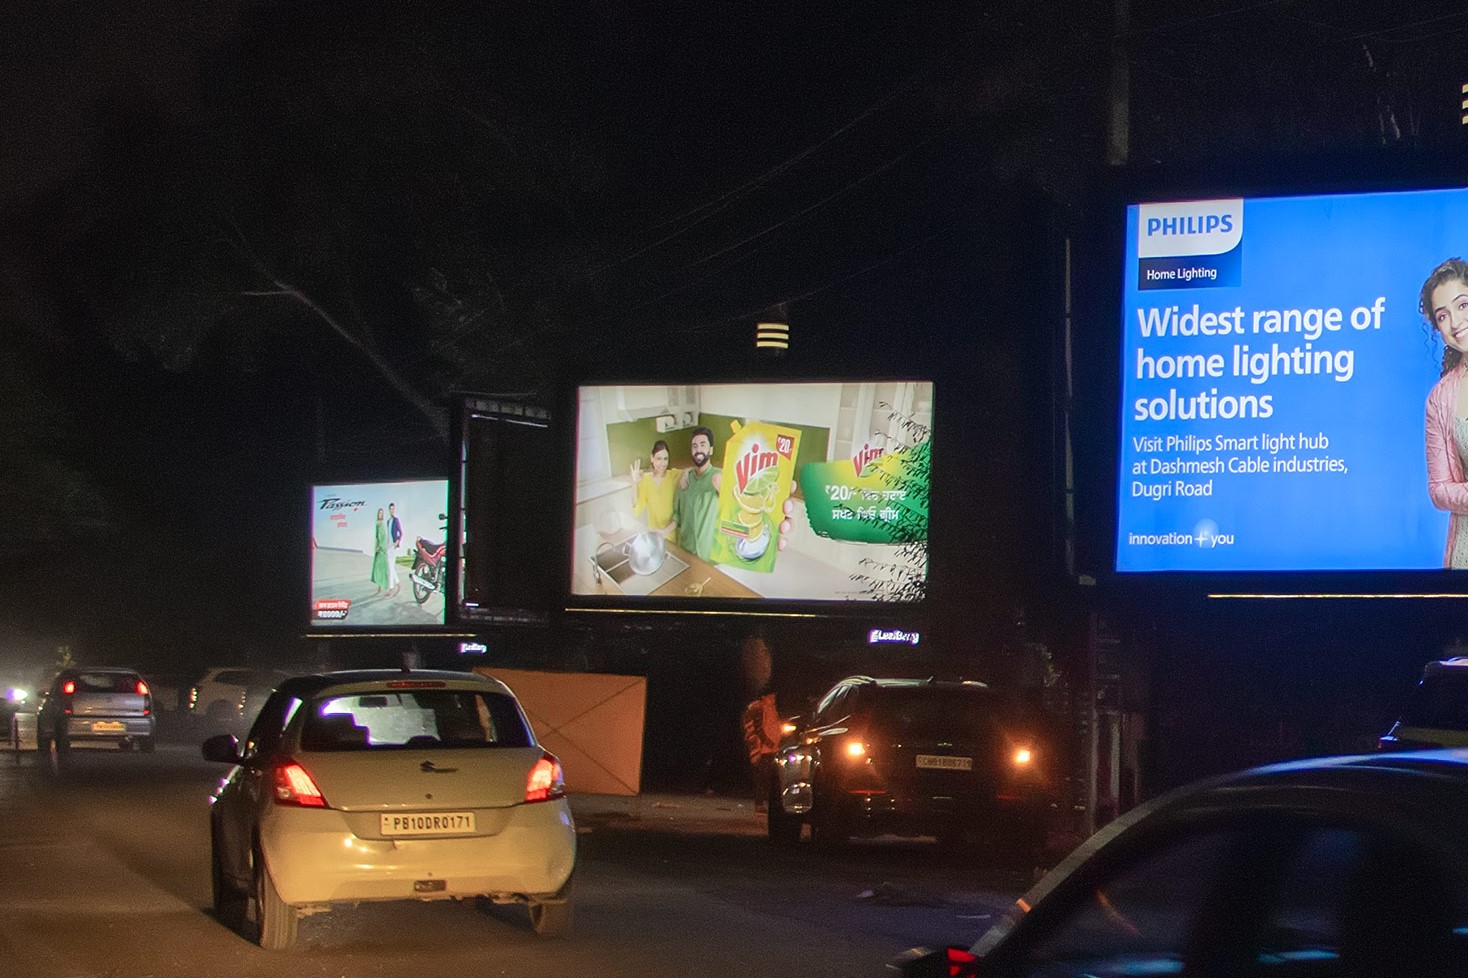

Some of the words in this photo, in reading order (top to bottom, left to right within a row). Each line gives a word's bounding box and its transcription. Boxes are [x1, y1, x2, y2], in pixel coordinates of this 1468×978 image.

[1147, 214, 1233, 236] PHILIPS
[1146, 269, 1176, 281] Home
[1177, 267, 1217, 281] Lighting
[1137, 304, 1245, 338] Widest
[1252, 306, 1343, 340] range
[1350, 297, 1386, 330] of
[1136, 347, 1225, 380] home
[1233, 343, 1355, 384] lighting
[1134, 389, 1274, 421] solutions
[1133, 436, 1164, 452] Visit
[1166, 435, 1213, 455] Philips
[1215, 434, 1259, 451] Smart
[1262, 433, 1297, 454] light
[1299, 432, 1329, 449] hub
[736, 443, 778, 494] Vim
[1132, 460, 1147, 475] at
[1150, 458, 1225, 475] Dashmesh
[1228, 456, 1270, 474] Cable
[1273, 457, 1349, 474] industries,
[1132, 481, 1173, 501] Dugri
[1175, 480, 1213, 497] Road
[1128, 532, 1193, 546] innovation
[1210, 534, 1235, 548] you
[393, 816, 470, 830] PB10DR0171
